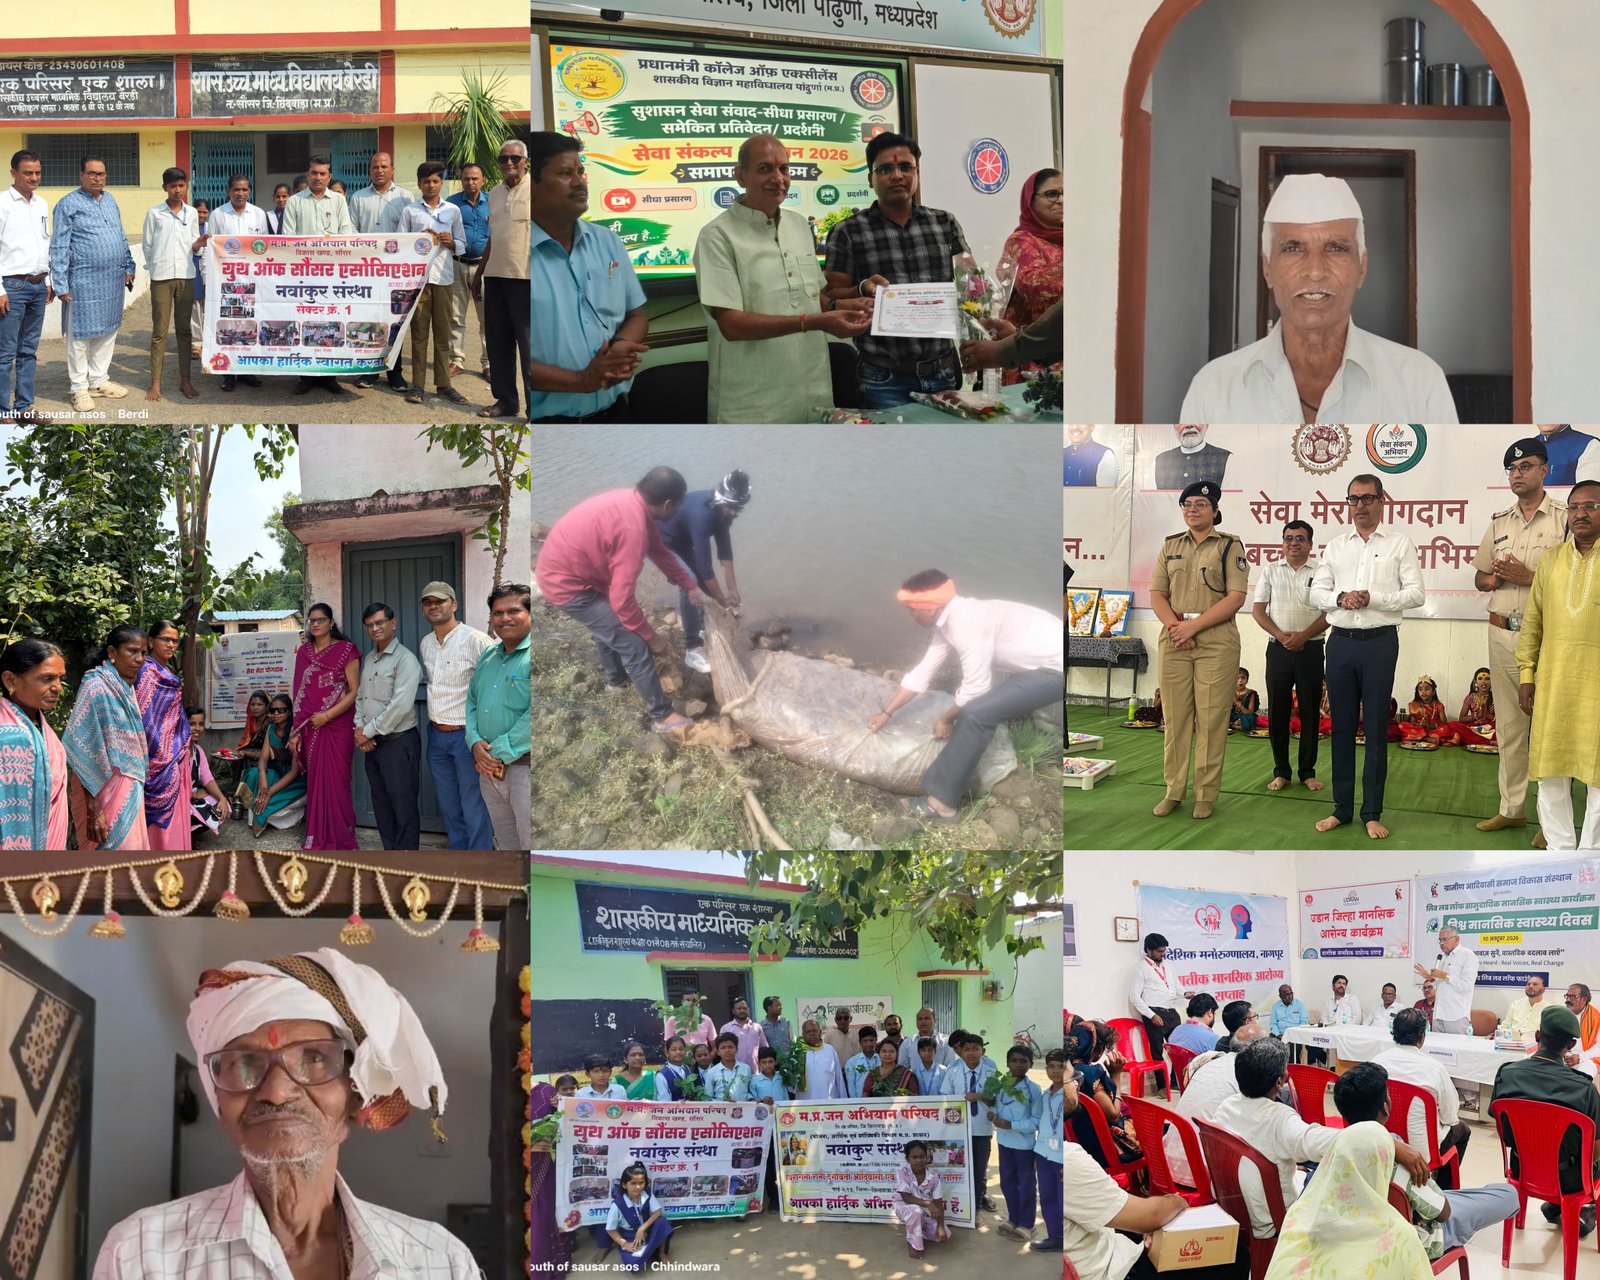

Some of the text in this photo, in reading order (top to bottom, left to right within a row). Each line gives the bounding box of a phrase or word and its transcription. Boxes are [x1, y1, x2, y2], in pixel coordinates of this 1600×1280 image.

[875, 2, 938, 30] मध्यप्रदेश
[637, 58, 700, 73] प्रधानमंत्री
[704, 60, 745, 75] कॉलेज
[22, 72, 110, 92] परिसर एक
[653, 74, 699, 86] शासकीय
[703, 76, 733, 88] विज्ञान
[0, 91, 24, 102] ासकीय
[83, 91, 116, 102] विद्यालय
[107, 103, 115, 111] 12
[631, 104, 686, 121] सुशासन
[690, 102, 717, 117] सेवा
[797, 110, 837, 123] प्रसारण
[661, 119, 715, 135] समेकित
[783, 122, 825, 137] प्रदर्शनी
[632, 143, 733, 161] सेवा संकल्प
[809, 148, 848, 161] 2026
[687, 166, 735, 179] समाप
[642, 195, 662, 203] सीधा
[312, 239, 347, 248] अभियान
[254, 258, 286, 276] ऑफ
[290, 257, 334, 276] सौंसर
[338, 257, 427, 279] एसोसिएशन
[275, 280, 373, 304] नवांकुर संस्था
[296, 304, 324, 315] सेक्टर
[345, 305, 352, 315] 1
[237, 355, 274, 366] आपका
[277, 353, 312, 368] हार्दिक
[315, 357, 353, 368] स्वागत
[1250, 490, 1352, 525] सेवा मेरा
[1444, 881, 1465, 892] ग्रामीण
[1466, 879, 1495, 890] आदिवासी
[1496, 878, 1518, 887] समाज
[1519, 875, 1543, 885] विकास
[1544, 872, 1572, 883] संस्थान
[1501, 896, 1532, 908] मानसिक
[1561, 893, 1596, 904] कार्यक्रम
[597, 905, 676, 933] शासकीय
[677, 910, 754, 937] माध्यमिक
[1332, 909, 1356, 922] जिल्हा
[1359, 906, 1395, 920] मानसिक
[1468, 915, 1515, 931] मानसिक
[1516, 914, 1558, 929] स्वास्थ्य
[1559, 911, 1594, 927] दिवस
[1320, 924, 1384, 939] आरोग्य कार्यक्रम
[1212, 967, 1284, 983] मानसिक आरोग्य
[1215, 989, 1246, 1002] सप्ताह
[667, 1106, 700, 1115] अभियान
[848, 1107, 898, 1121] अभियान
[607, 1122, 641, 1140] ऑफ
[645, 1121, 687, 1140] सौंसर
[691, 1121, 764, 1140] एसोसिएशन
[629, 1142, 719, 1162] नवांकुर संस्था
[826, 1140, 874, 1161] नवांकुर
[648, 1162, 675, 1173] सेक्टर
[693, 1162, 700, 1171] 1
[790, 1194, 859, 1211] आपका हार्दिक
